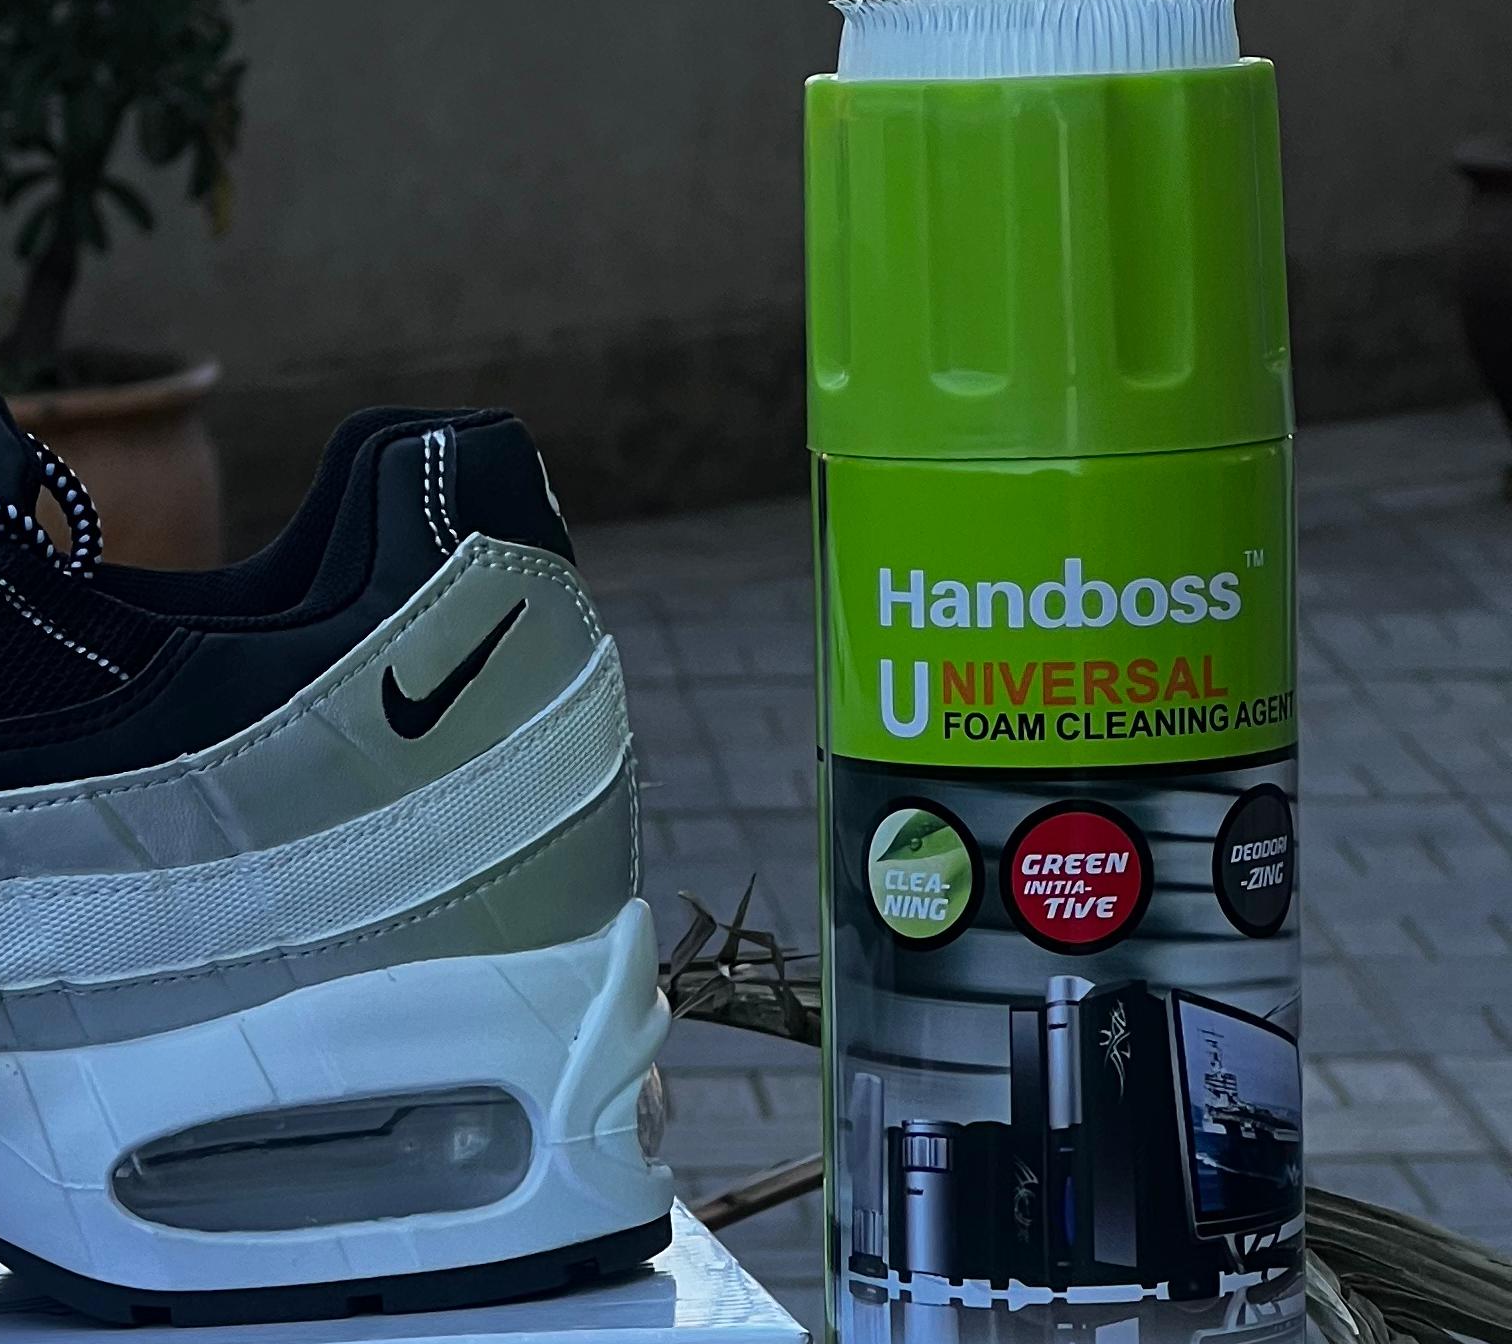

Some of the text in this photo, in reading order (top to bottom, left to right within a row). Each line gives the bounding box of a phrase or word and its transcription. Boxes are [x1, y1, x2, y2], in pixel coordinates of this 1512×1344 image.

[878, 557, 1243, 629] Handboss
[943, 689, 1295, 742] FOAM CLEANING AGENT
[1021, 851, 1130, 876] GREEN
[1023, 879, 1093, 896] INITIA-
[882, 895, 949, 922] NING
[1042, 895, 1118, 920] TIVE
